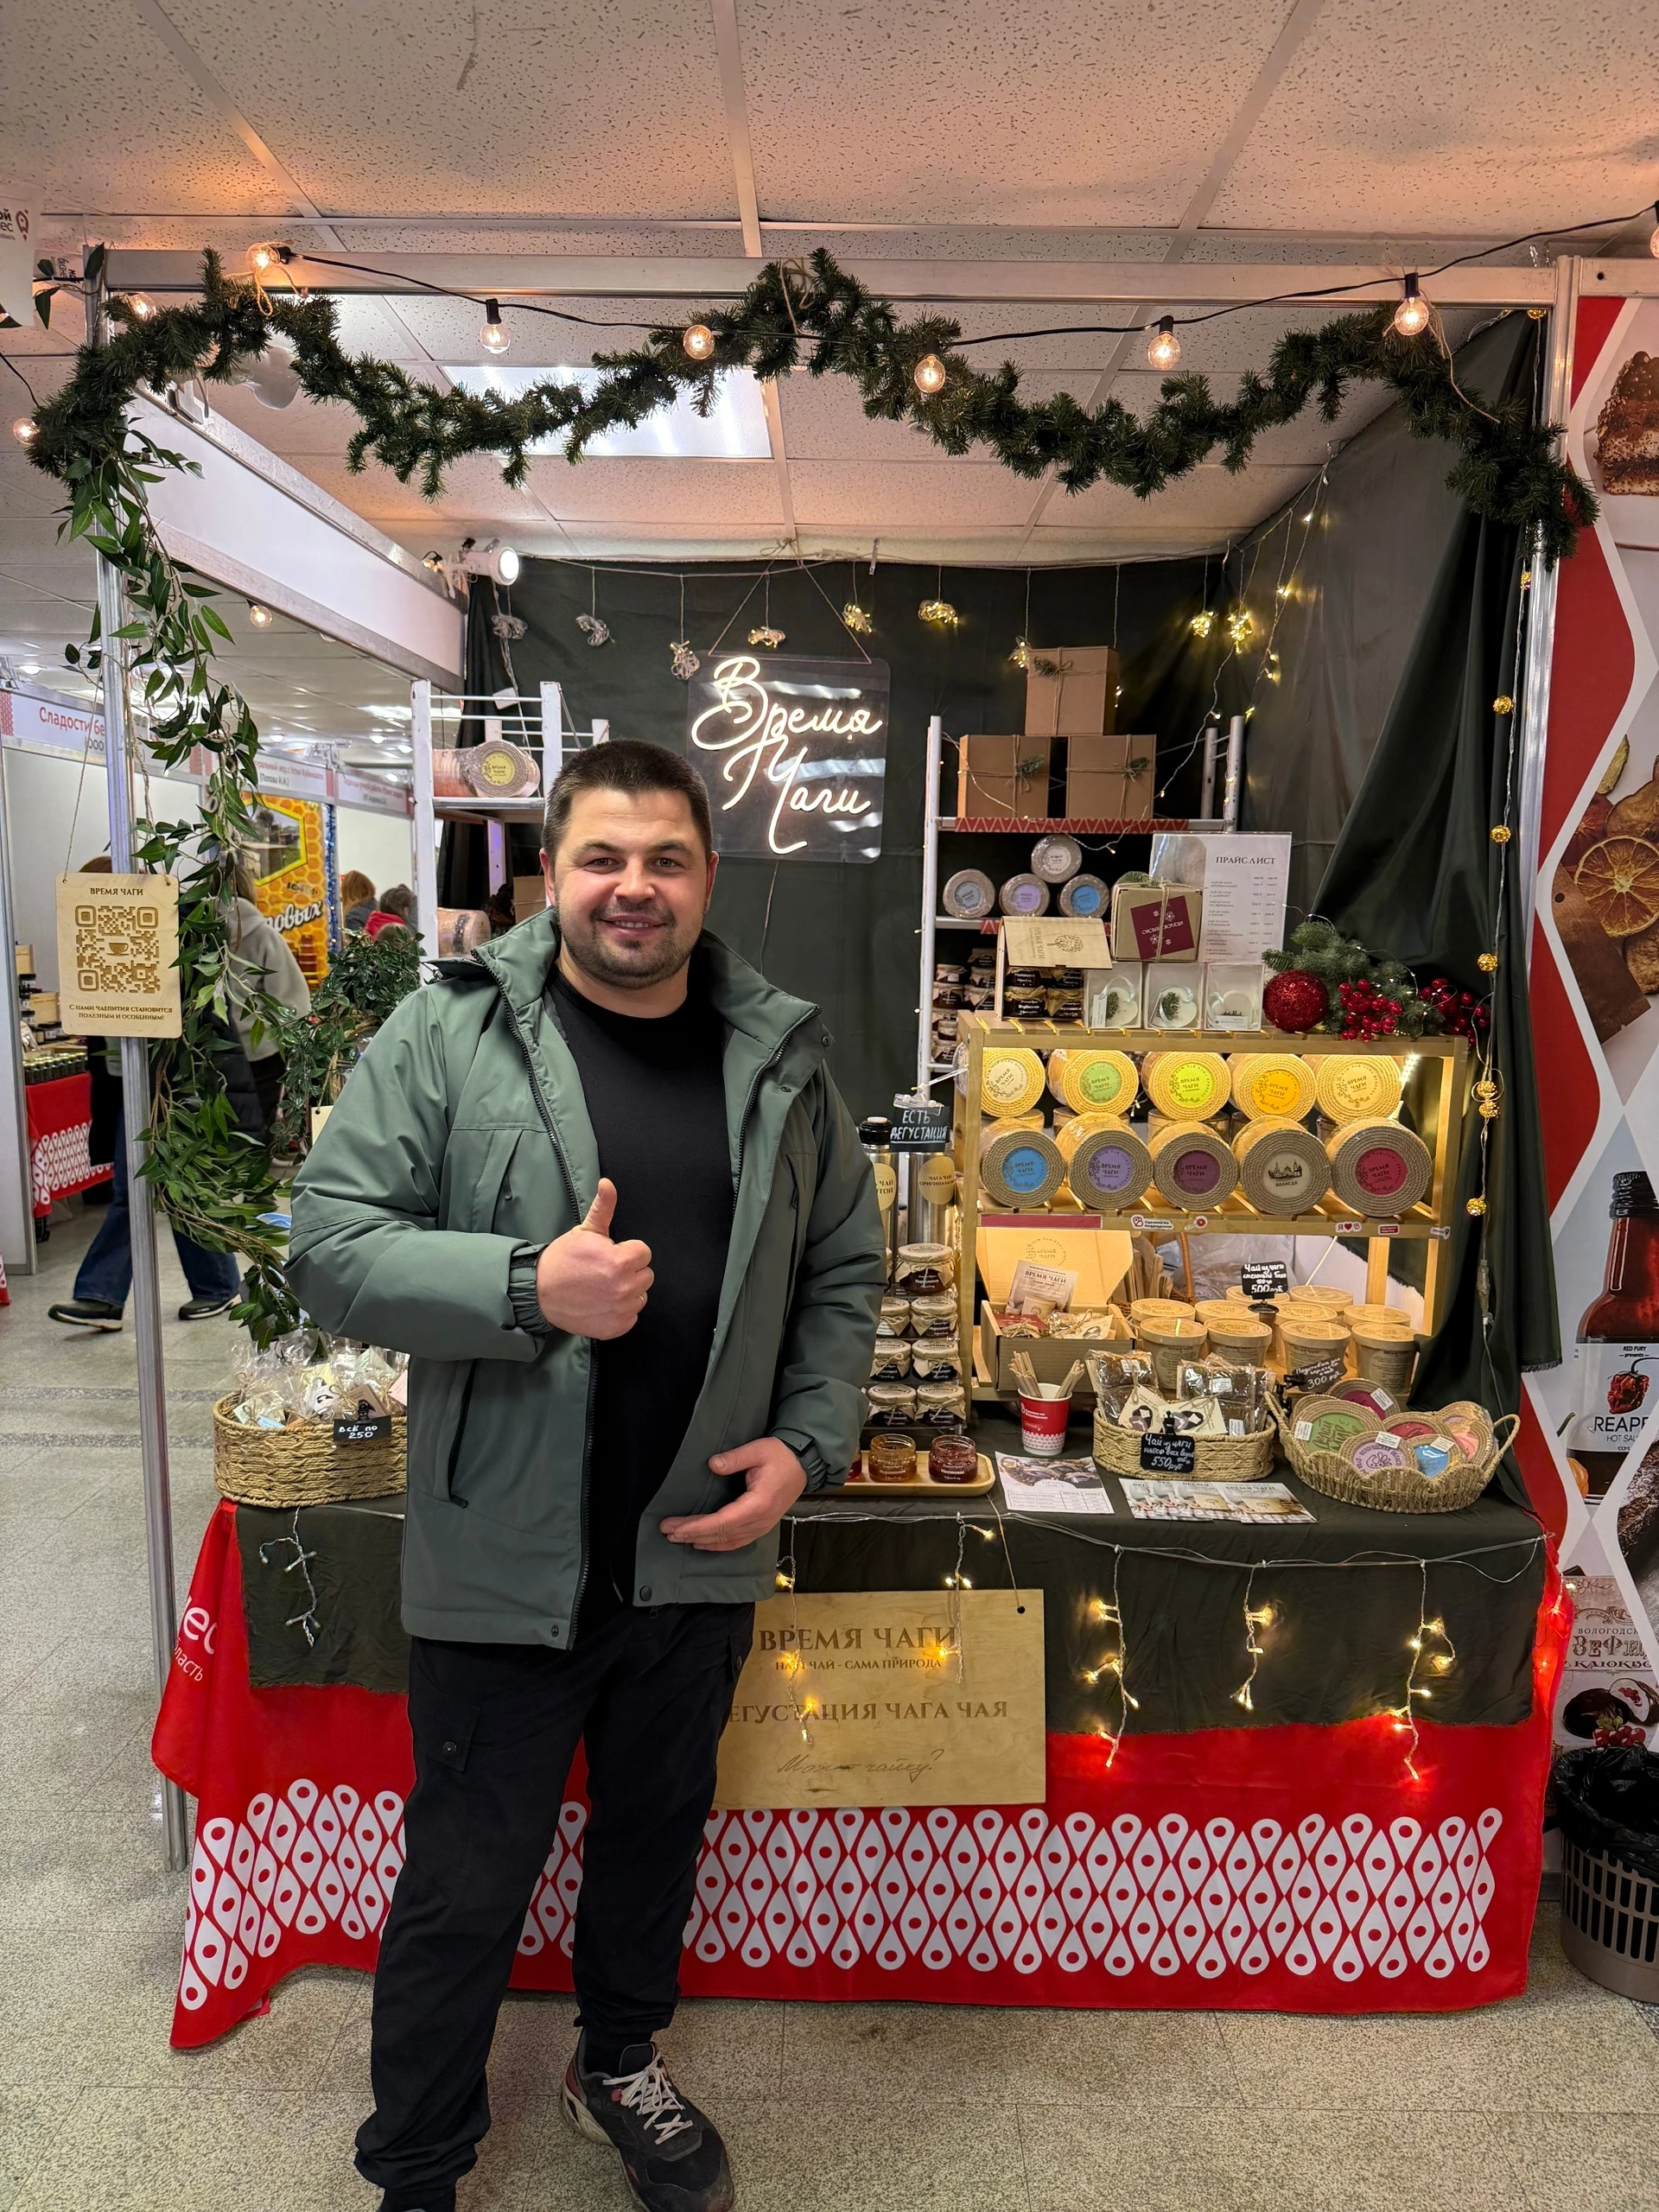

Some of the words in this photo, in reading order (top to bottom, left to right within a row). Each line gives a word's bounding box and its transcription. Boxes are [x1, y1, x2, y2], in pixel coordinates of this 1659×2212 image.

[39, 706, 90, 732] Сладости
[691, 656, 882, 810] Время
[723, 734, 871, 854] Чаги
[1268, 1083, 1288, 1091] ВРЕМЯ
[1347, 1076, 1367, 1085] ВРЕМЯ
[902, 1109, 931, 1124] ЕСТЬ
[1244, 1263, 1261, 1272] Чай
[1025, 1270, 1047, 1280] ВРЕМЯ
[1048, 1274, 1066, 1284] ЧАГИ
[1307, 1376, 1327, 1389] 300
[1145, 1433, 1162, 1446] Чай
[759, 1628, 862, 1651] ВРЕМЯ
[873, 1626, 957, 1649] ЧАГИ
[1573, 1636, 1647, 1658] ЗЕФИ
[810, 1660, 835, 1669] ЧАЙ
[845, 1660, 880, 1669] САМА
[882, 1658, 942, 1669] ПРИРОДА
[730, 1703, 876, 1724] ЕГУСТАЦИЯ
[886, 1702, 950, 1719] ЧАГА
[957, 1701, 1007, 1719] ЧАЯ
[867, 1748, 944, 1783] чайку?
